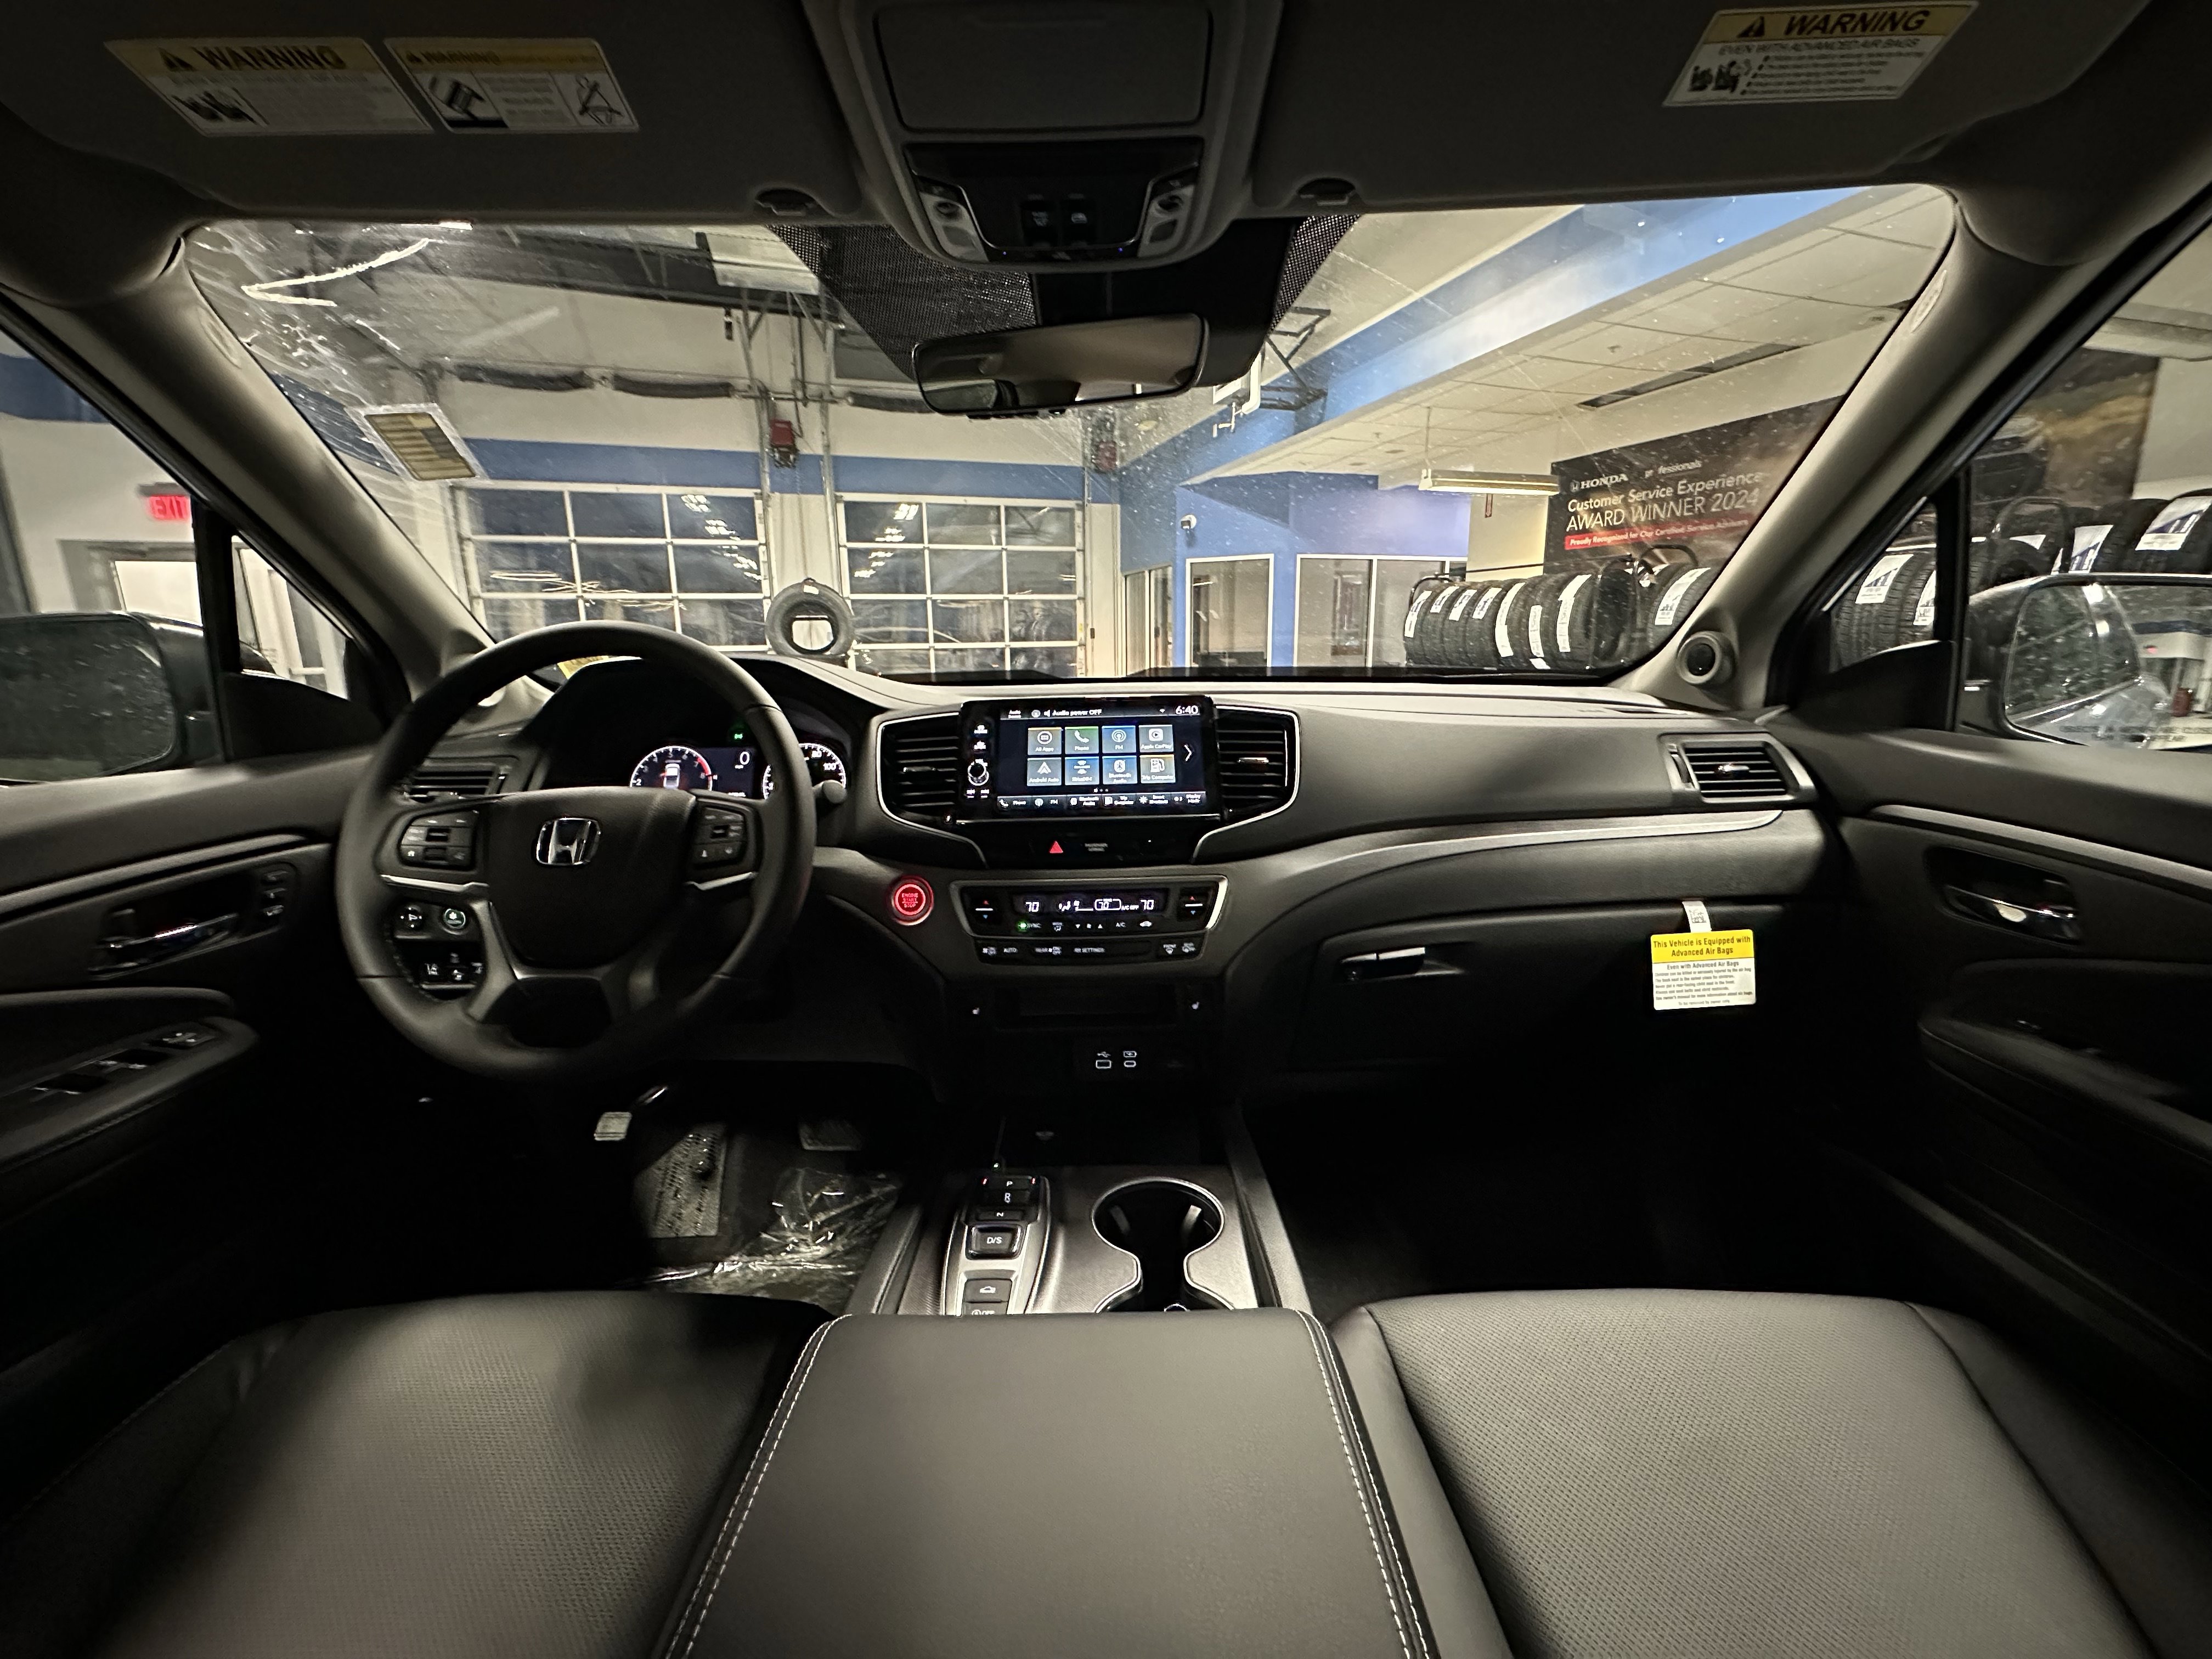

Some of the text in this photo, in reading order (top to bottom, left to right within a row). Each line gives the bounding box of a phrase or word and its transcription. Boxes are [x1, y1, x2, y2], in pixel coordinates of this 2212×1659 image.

[1784, 10, 1930, 36] WARNING
[191, 46, 347, 71] WARNING
[1580, 473, 1628, 489] HONDA
[1568, 472, 1761, 513] Customer Service Experience
[155, 495, 187, 519] EXIT
[1566, 488, 1759, 532] AWARD WINNER 2024
[1175, 705, 1199, 715] 6:40
[740, 751, 750, 765] 0
[1025, 901, 1040, 912] 70
[1140, 899, 1154, 910] 70
[1669, 939, 1694, 947] Vehicle
[1704, 936, 1734, 946] Equipped
[1672, 948, 1703, 957] Advanced
[1717, 946, 1734, 955] Bags
[986, 1236, 1003, 1245] D/S
